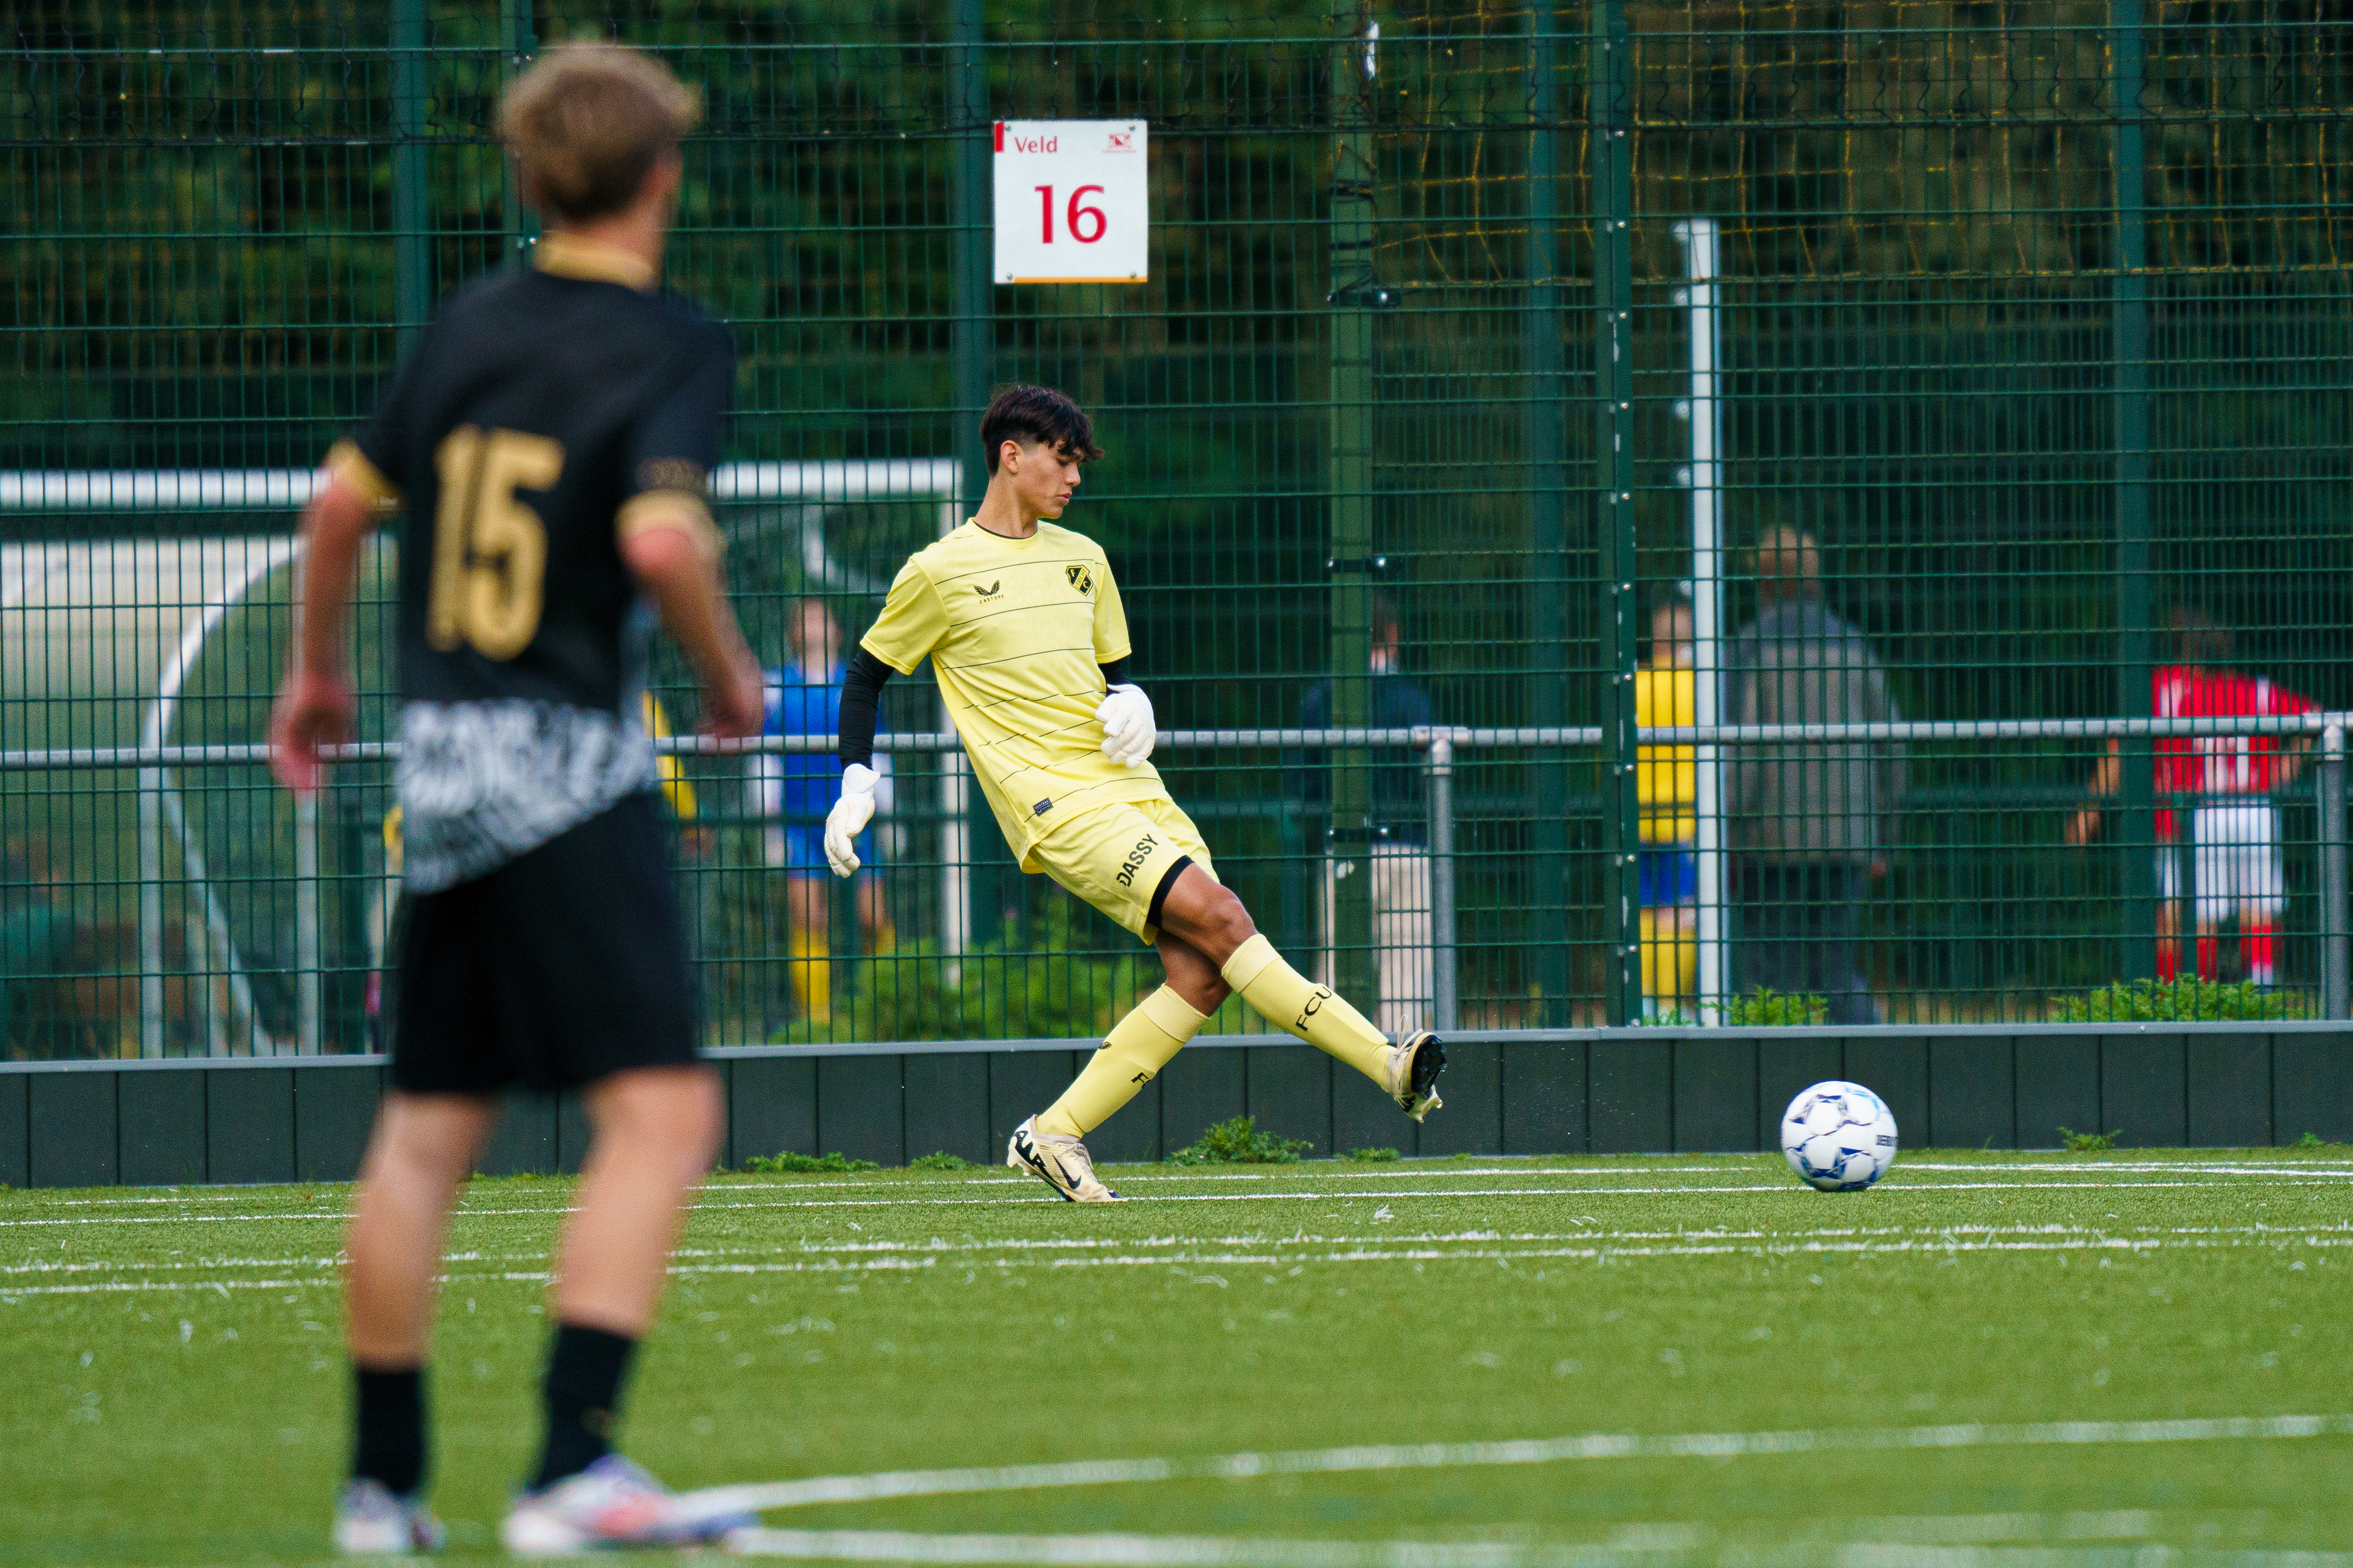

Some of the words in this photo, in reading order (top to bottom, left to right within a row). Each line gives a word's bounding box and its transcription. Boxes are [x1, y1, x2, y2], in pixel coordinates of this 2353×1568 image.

[1014, 136, 1058, 154] Veld
[1034, 184, 1108, 244] 16
[426, 422, 566, 662] 15
[979, 594, 1004, 604] CASTORE
[1074, 568, 1087, 589] UTRECHT
[1116, 833, 1158, 887] DASSY
[1296, 986, 1332, 1031] FCU
